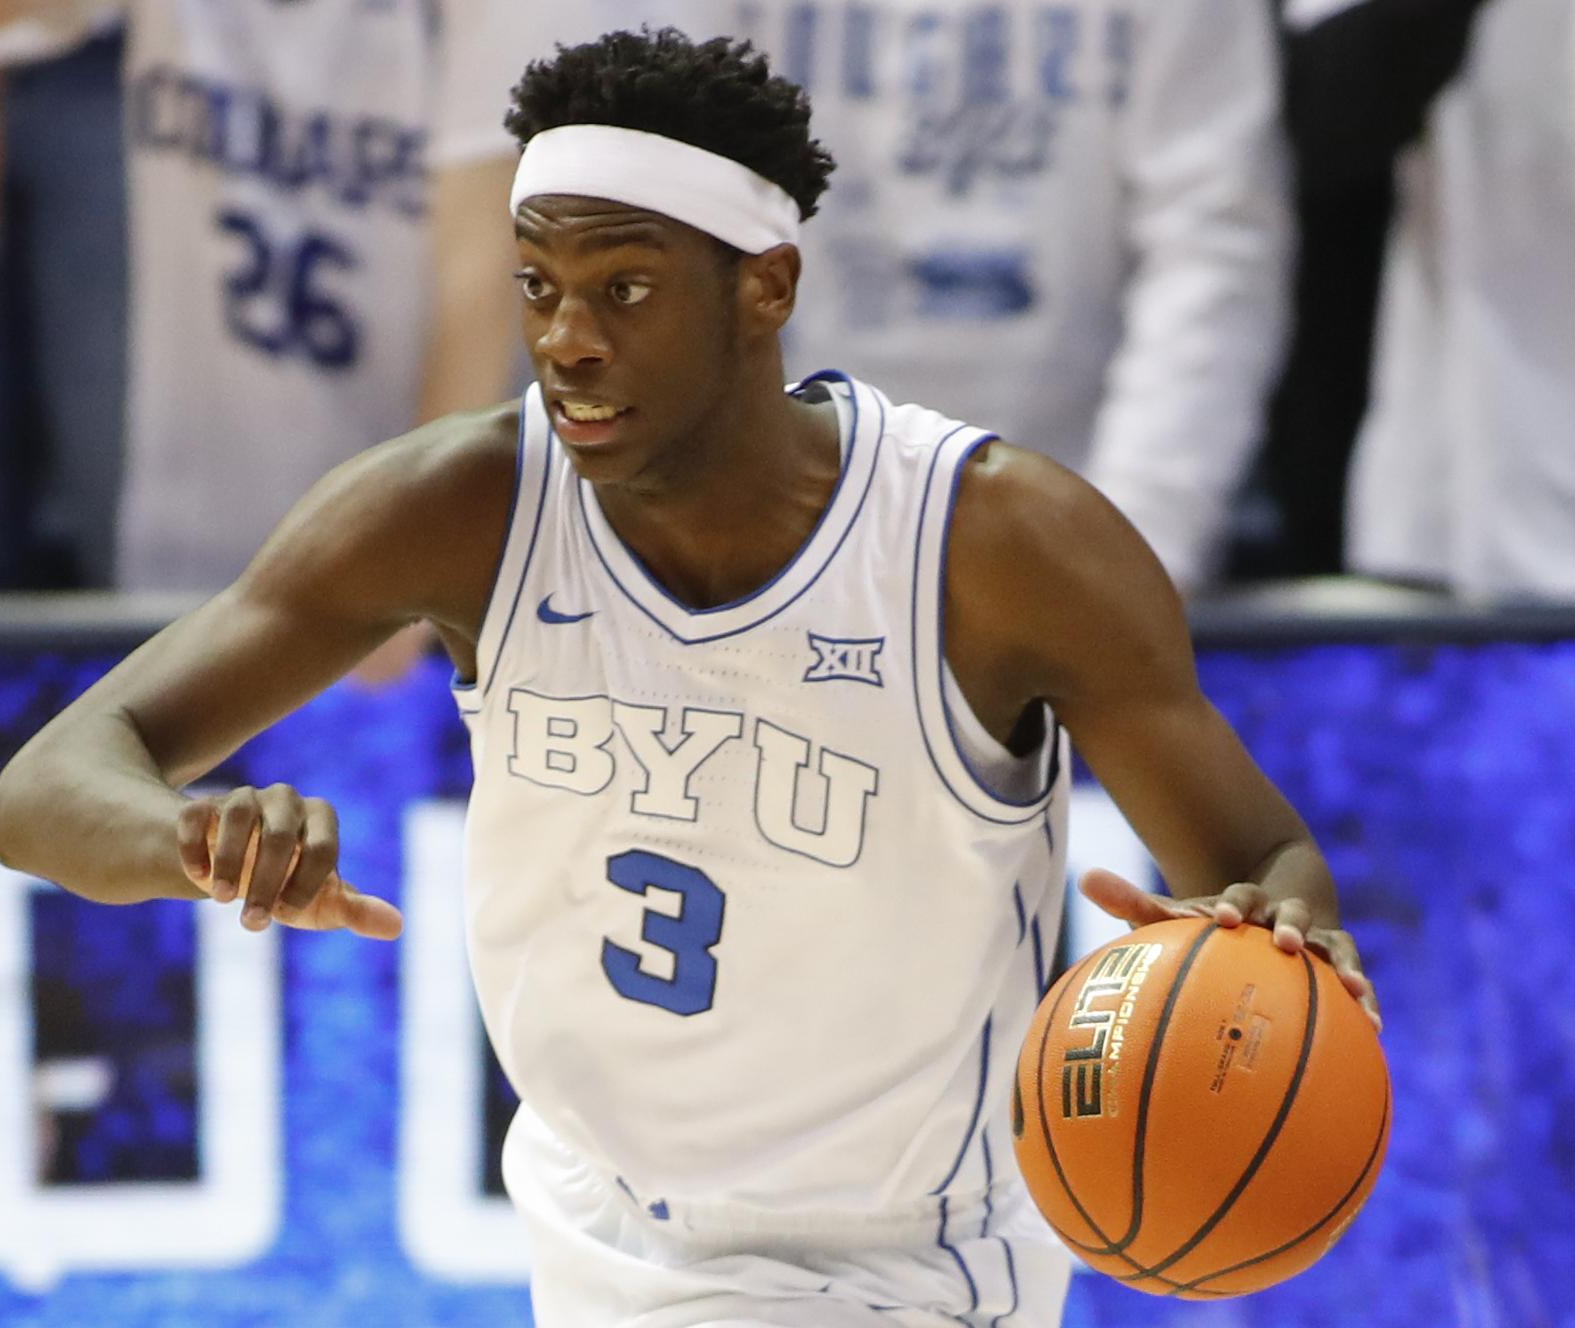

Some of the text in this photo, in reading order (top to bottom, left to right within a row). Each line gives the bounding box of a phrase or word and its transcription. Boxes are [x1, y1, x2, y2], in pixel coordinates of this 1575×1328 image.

[217, 208, 362, 372] 26
[507, 687, 880, 869] BYU
[600, 847, 727, 1017] 3
[1061, 943, 1152, 1120] ELITE
